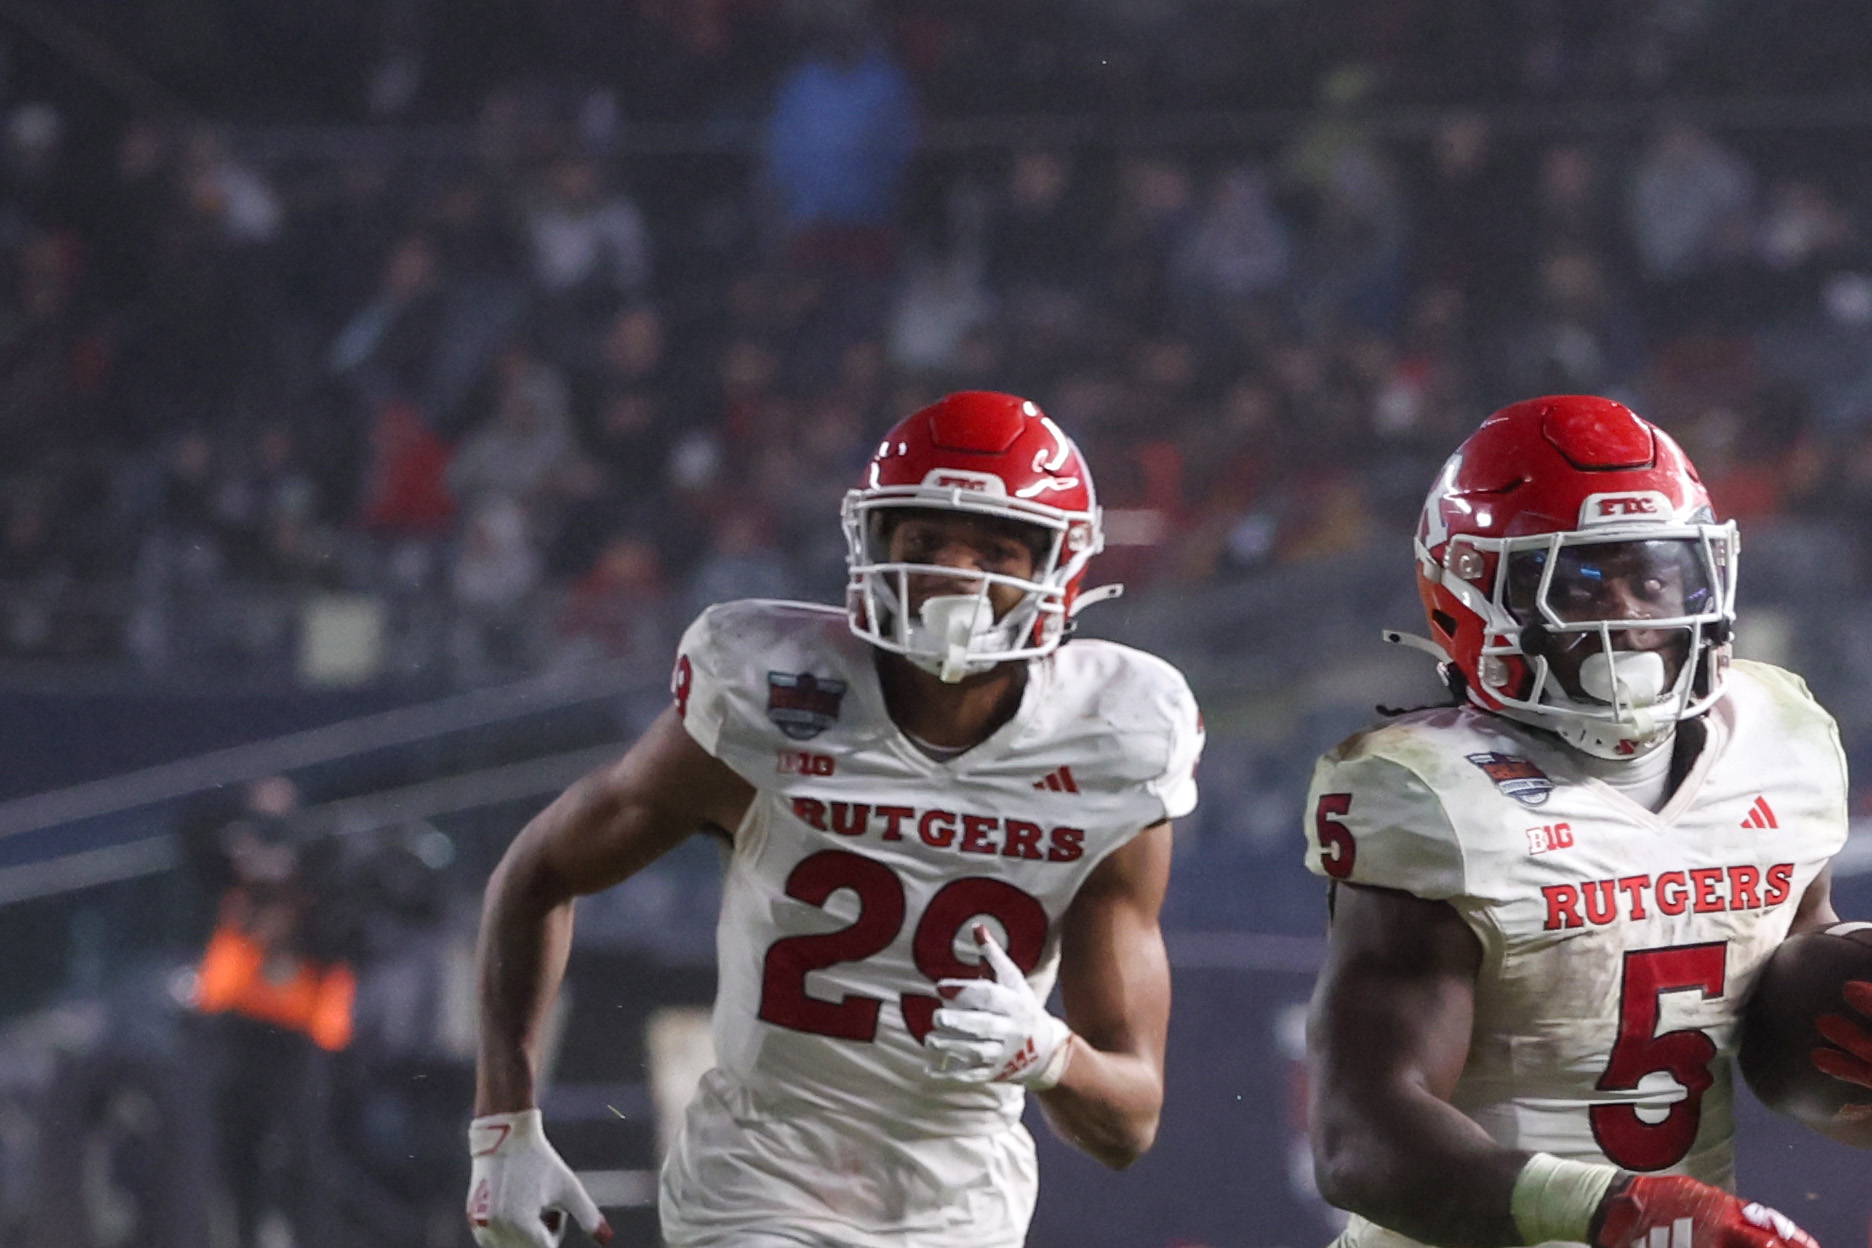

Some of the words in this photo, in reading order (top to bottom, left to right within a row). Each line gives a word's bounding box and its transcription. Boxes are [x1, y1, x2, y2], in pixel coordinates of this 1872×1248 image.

[791, 797, 1085, 862] RUTGERS
[1316, 793, 1356, 879] 5
[1541, 863, 1795, 931] RUTGERS
[1588, 941, 1729, 1172] 5
